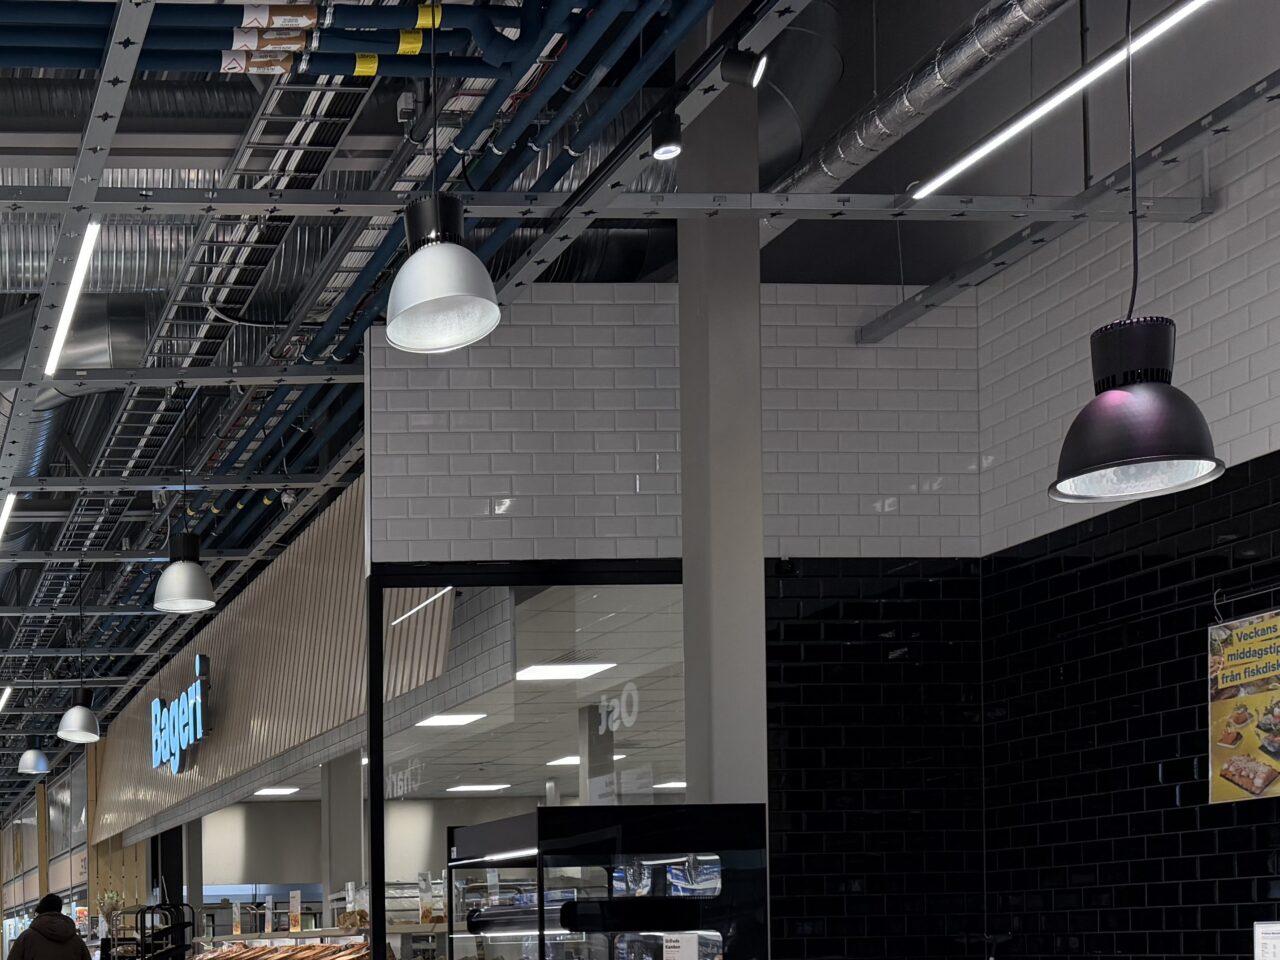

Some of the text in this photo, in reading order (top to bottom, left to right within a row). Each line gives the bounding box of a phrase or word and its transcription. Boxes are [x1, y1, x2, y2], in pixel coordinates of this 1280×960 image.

[1236, 625, 1278, 643] Veckans
[1222, 670, 1241, 684] från
[151, 654, 203, 775] Bageri
